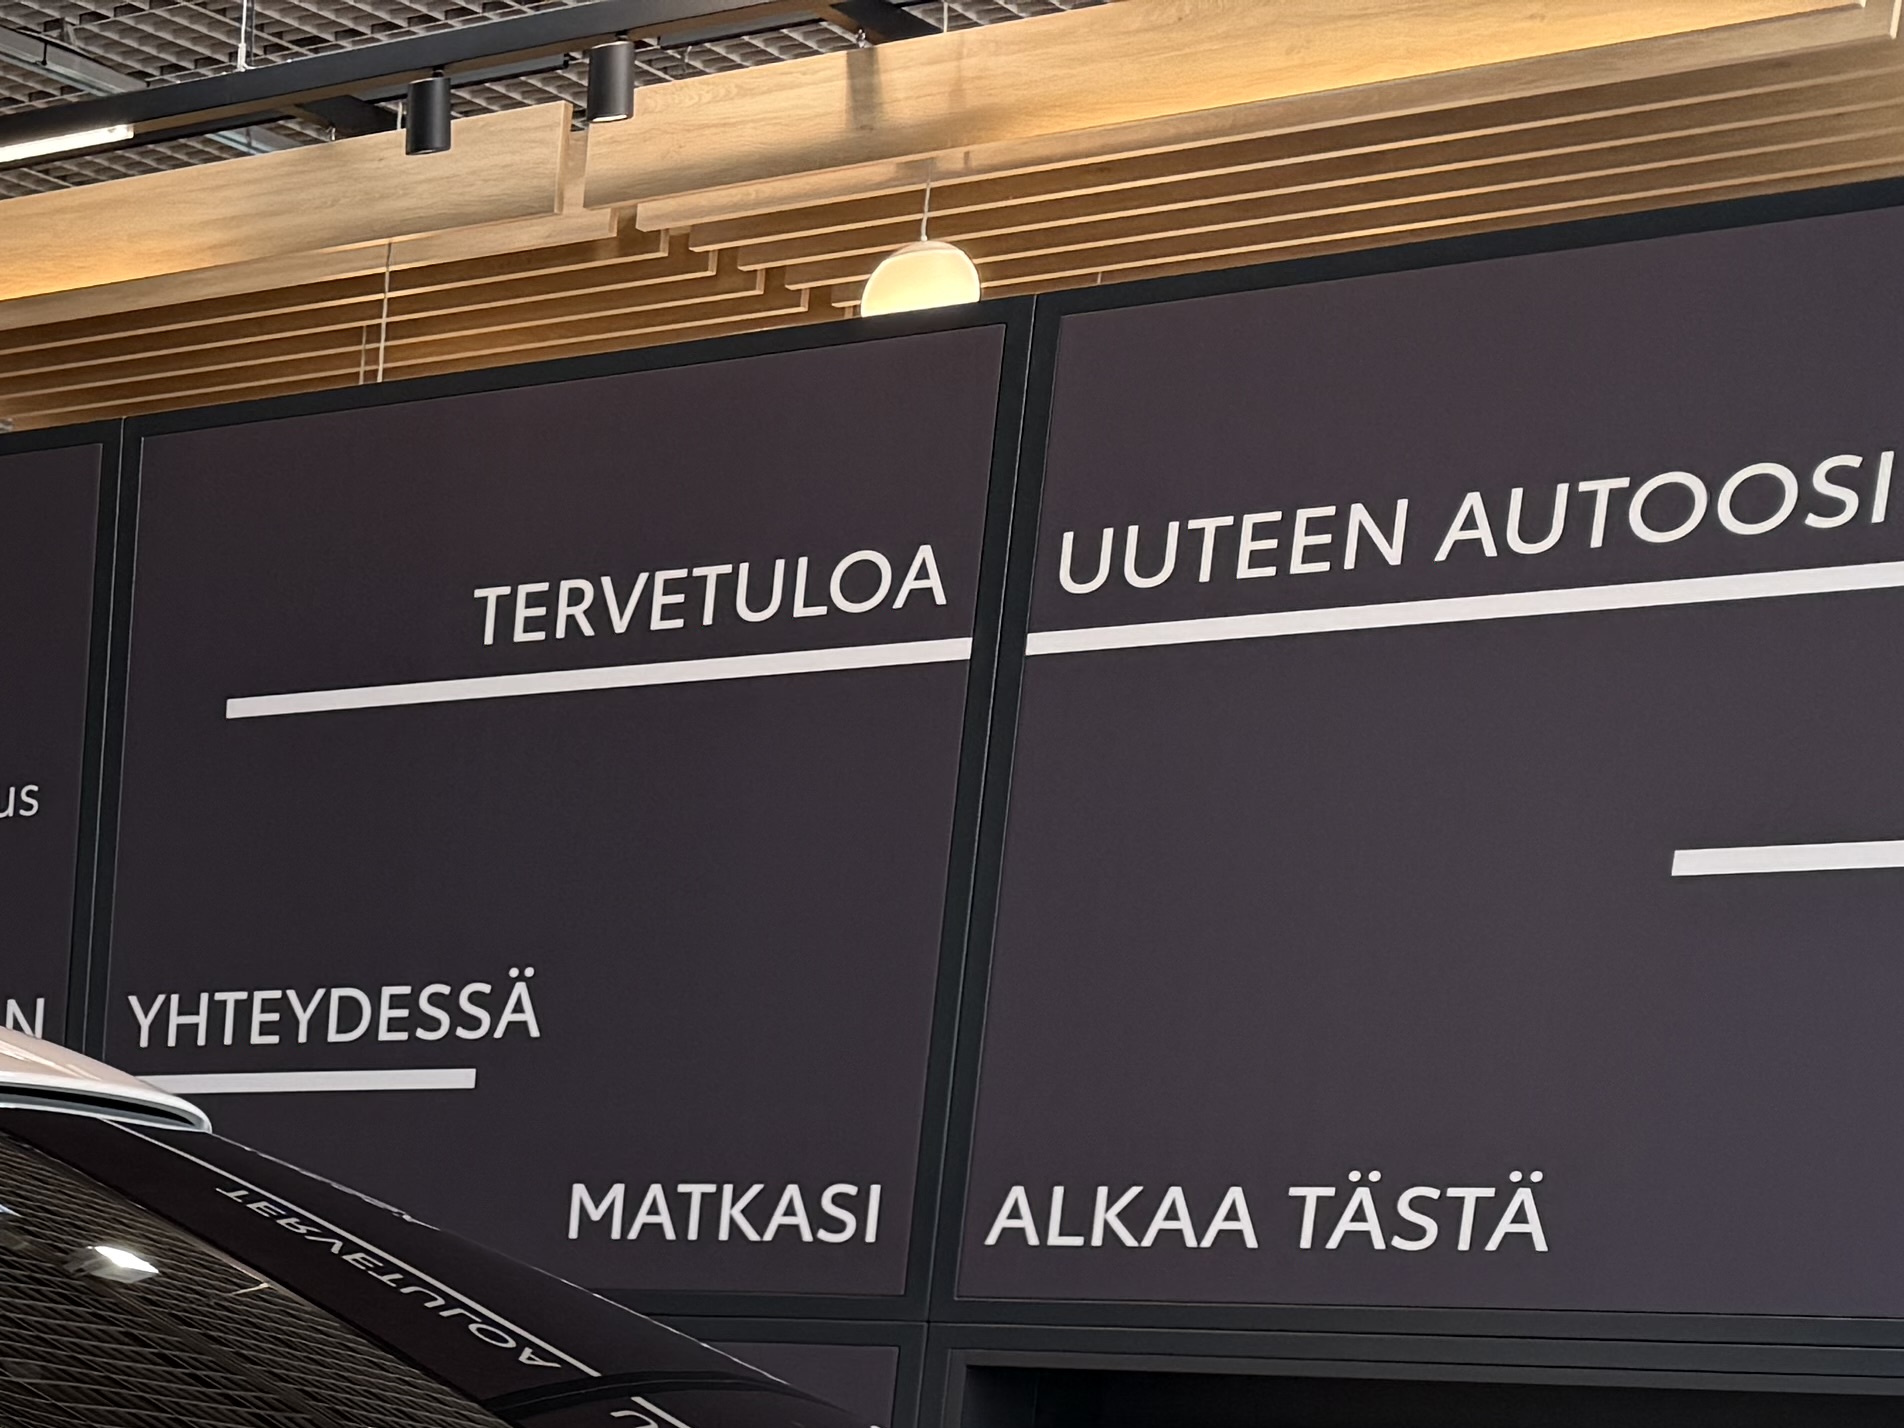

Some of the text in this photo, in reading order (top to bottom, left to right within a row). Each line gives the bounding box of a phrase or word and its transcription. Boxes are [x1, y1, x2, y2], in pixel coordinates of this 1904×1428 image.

[1059, 450, 1894, 594] UUTEEN AUTOOSI
[474, 545, 947, 646] TERVETULOA
[127, 966, 541, 1048] YHTEYDESSÄ
[568, 1183, 882, 1243] MATKASI
[984, 1170, 1549, 1252] ALKAA TÄSTÄ
